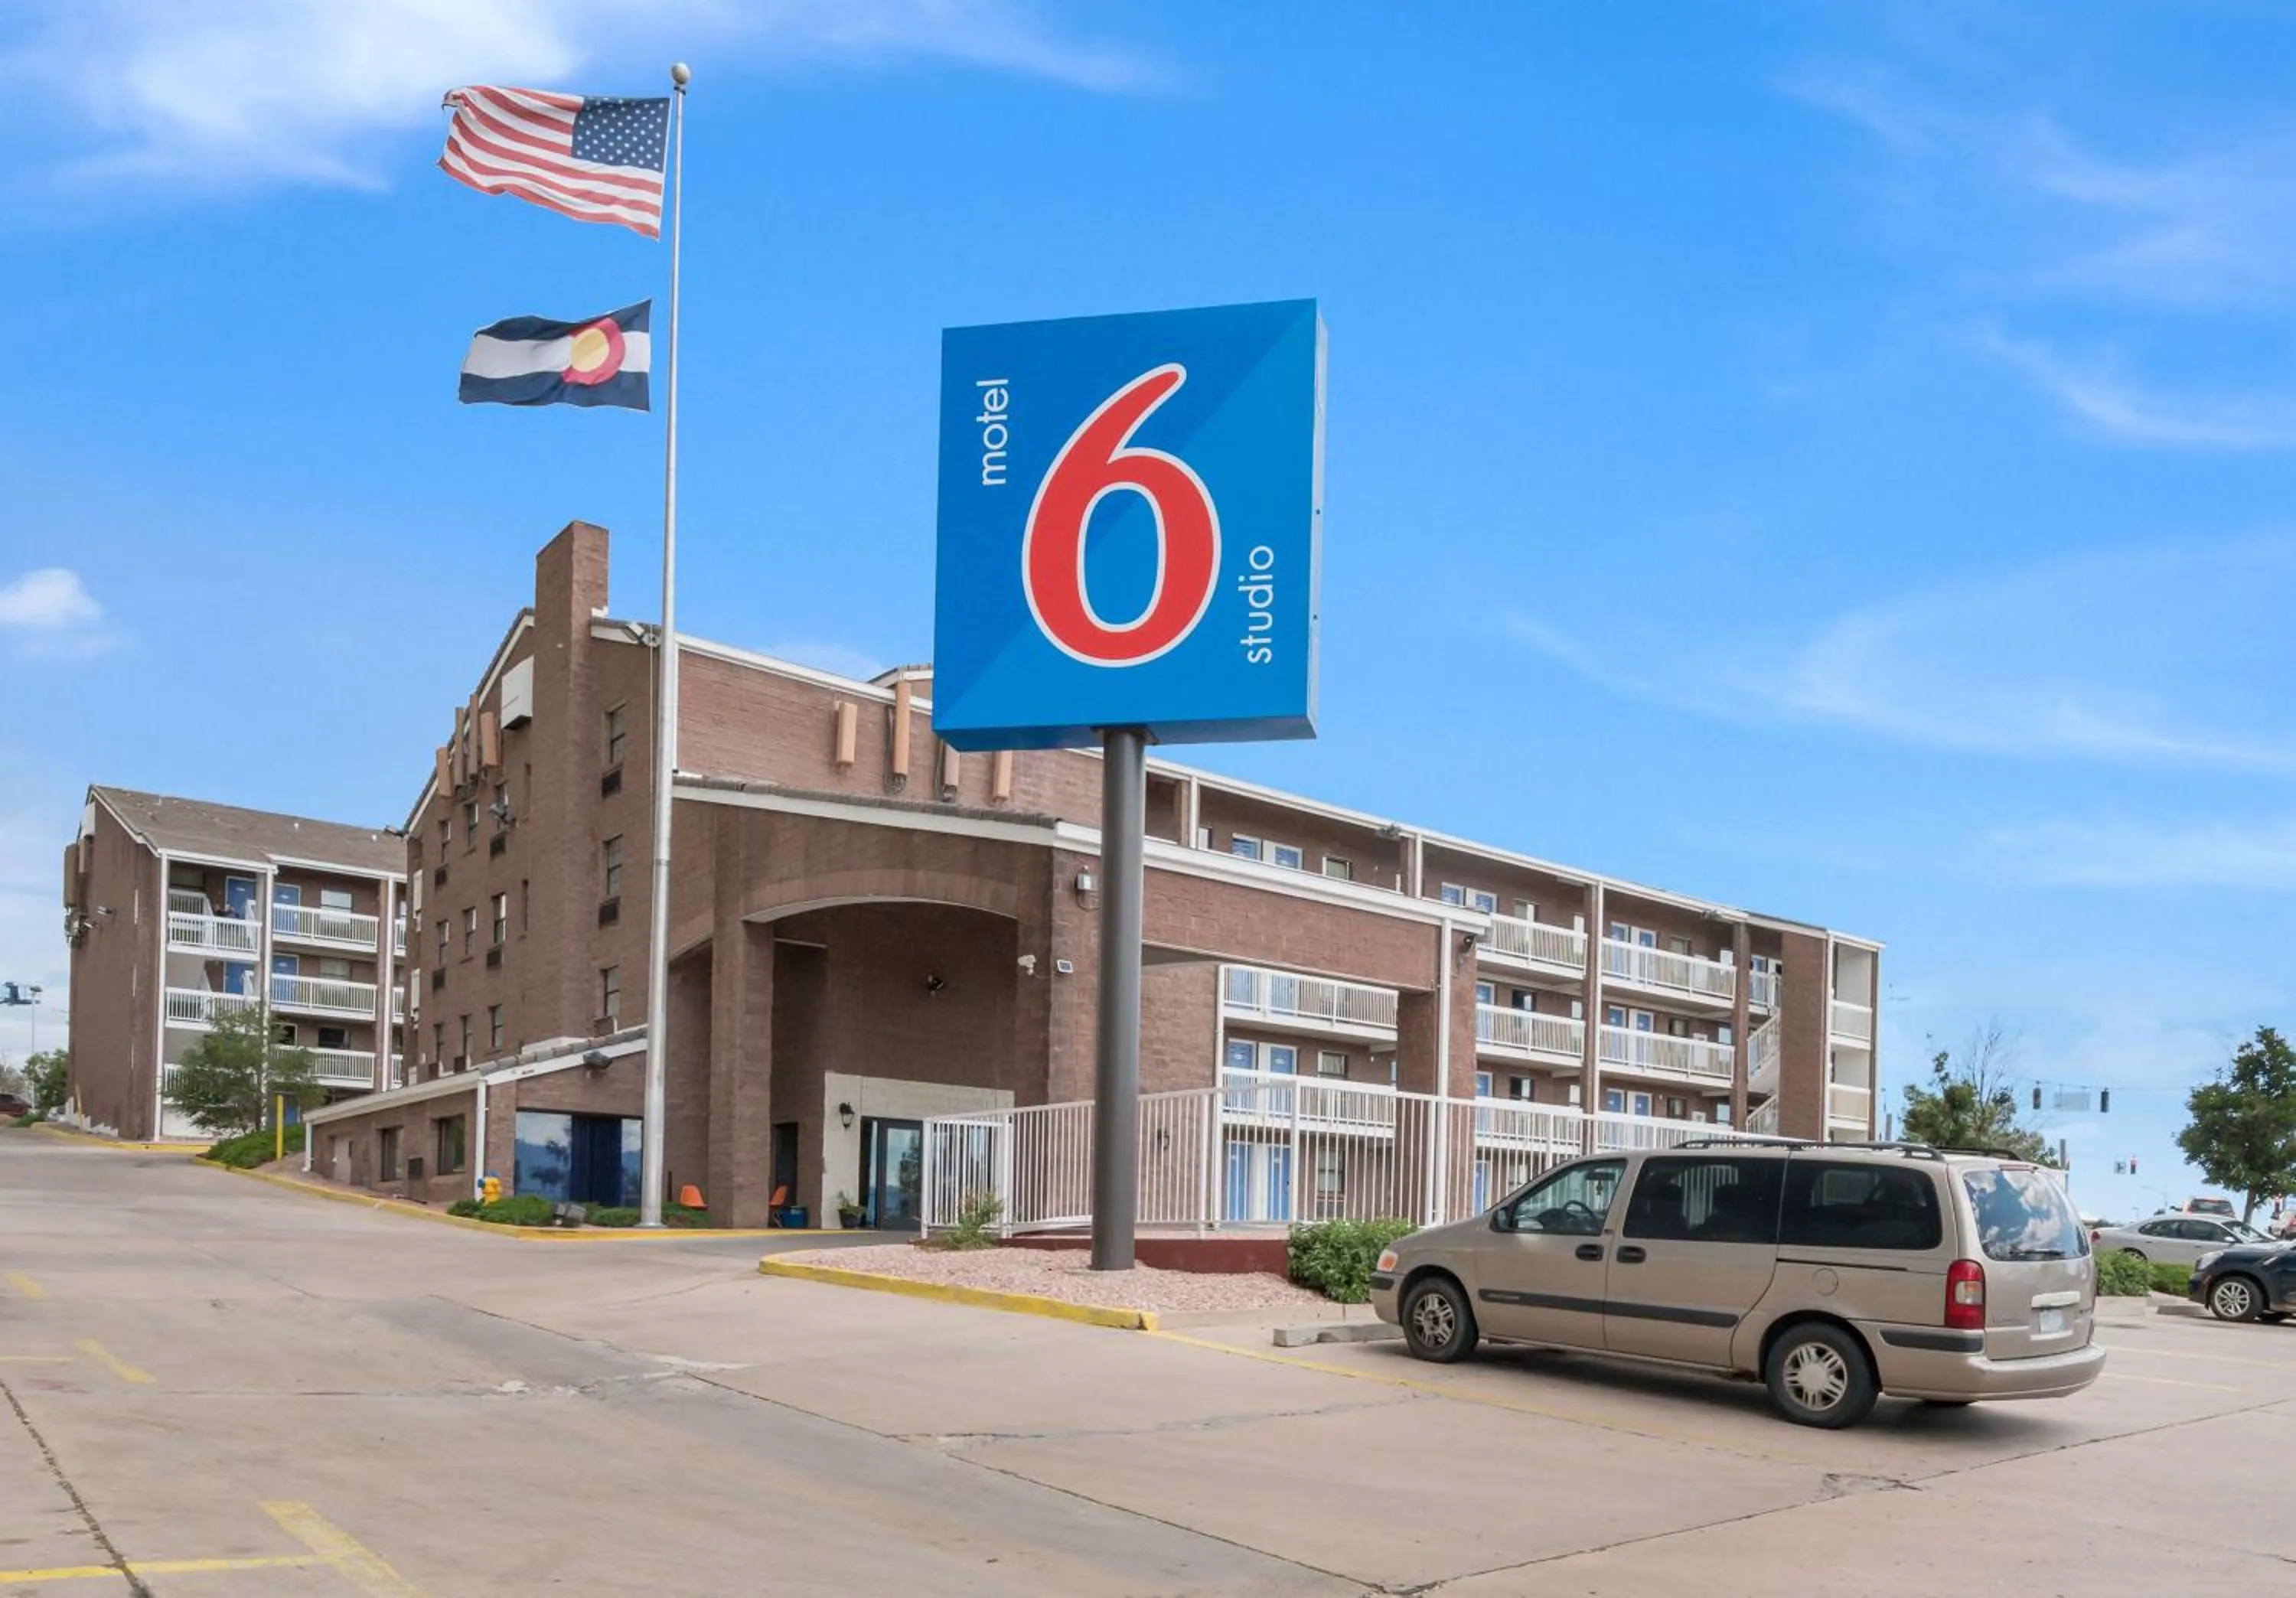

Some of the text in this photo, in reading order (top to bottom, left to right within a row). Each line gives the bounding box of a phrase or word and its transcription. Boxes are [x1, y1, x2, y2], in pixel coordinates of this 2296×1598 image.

[976, 379, 1009, 486] motel
[1022, 362, 1221, 668] 6
[1238, 545, 1274, 664] studio
